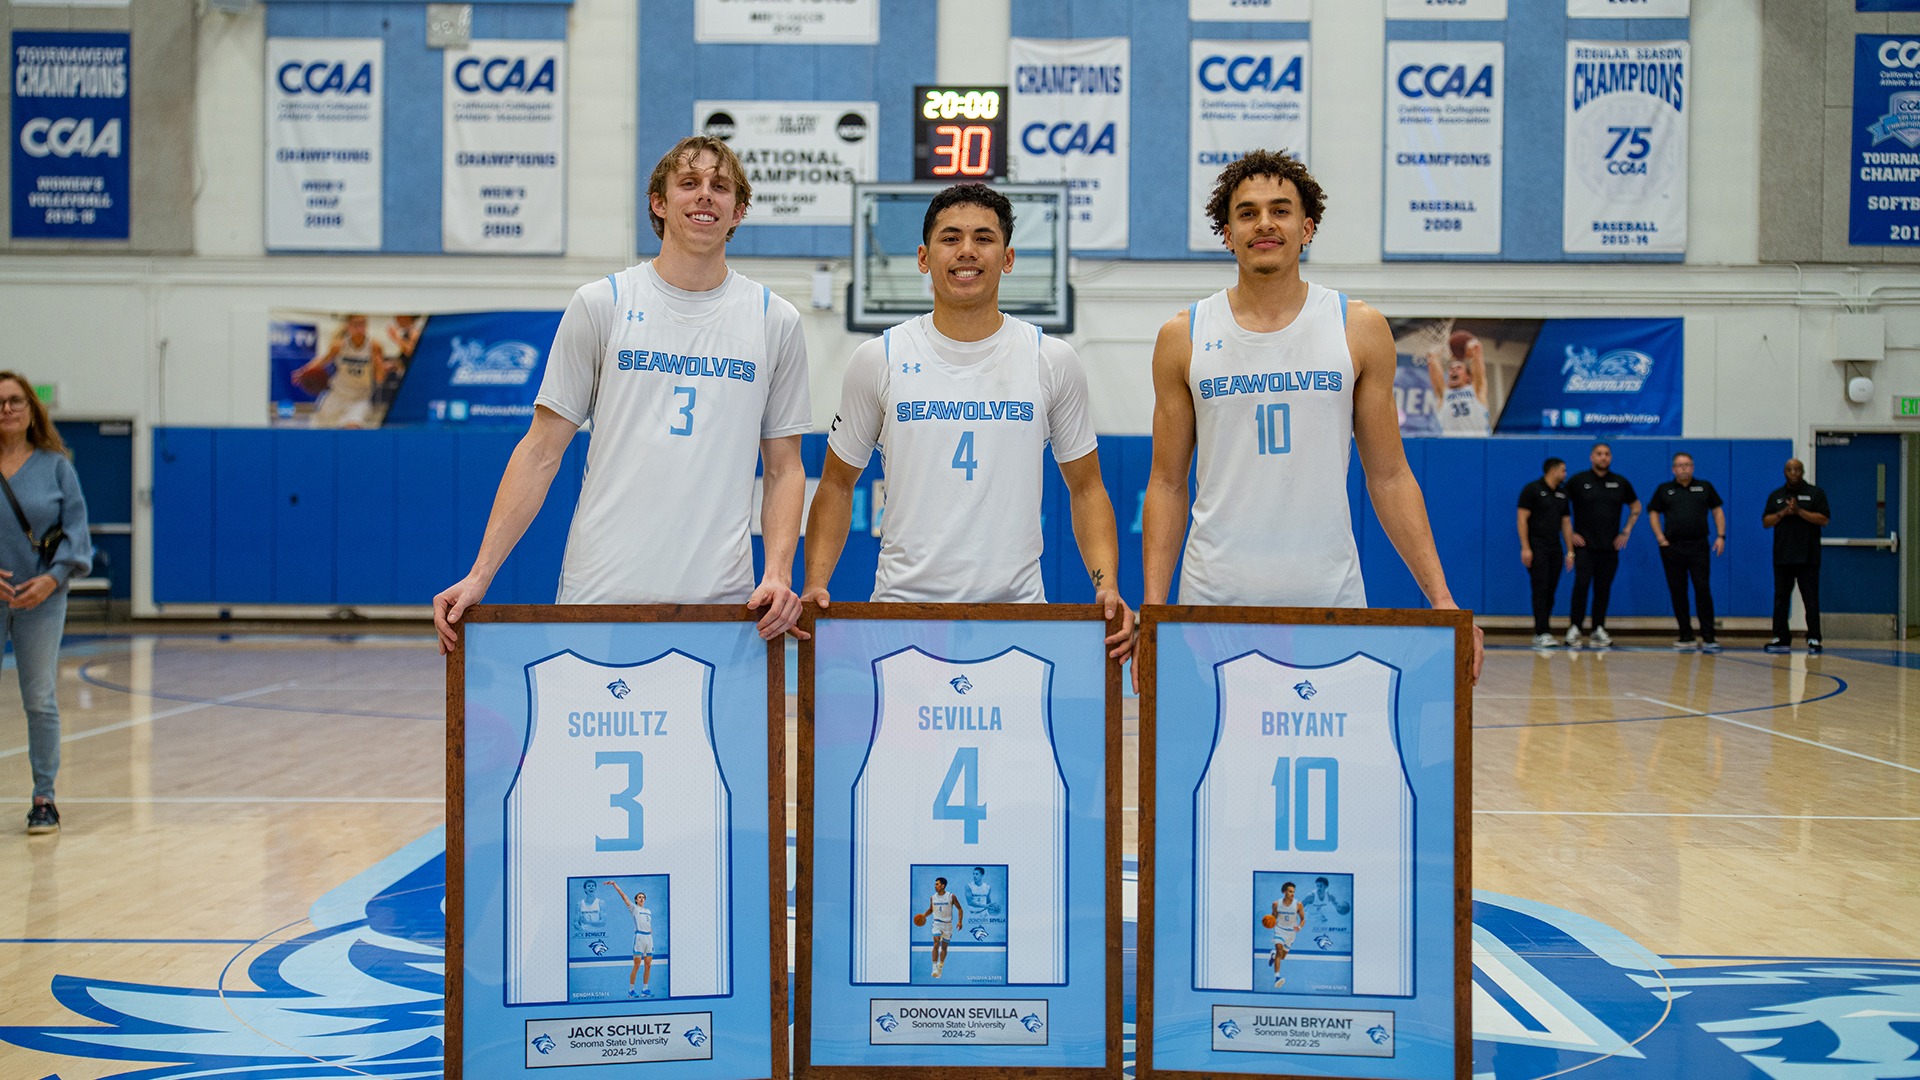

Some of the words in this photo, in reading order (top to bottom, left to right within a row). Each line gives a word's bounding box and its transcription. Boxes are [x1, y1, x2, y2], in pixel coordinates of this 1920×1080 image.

[1575, 47, 1629, 60] REGULAR
[1637, 47, 1683, 60] SEASON
[16, 65, 127, 98] CHAMPIONS
[278, 61, 372, 95] CCAA
[455, 58, 555, 93] CCAA
[1016, 65, 1123, 93] CHAMPIONS
[1198, 56, 1304, 92] CCAA
[1397, 65, 1494, 98] CCAA
[1573, 62, 1684, 113] CHAMPIONS
[923, 90, 1000, 119] 20:00
[20, 117, 121, 158] CCAA
[932, 125, 992, 176] 30
[1022, 122, 1116, 155] CCAA
[1604, 126, 1653, 160] 75
[737, 150, 843, 165] ATIONAL
[1397, 153, 1491, 166] CHAMPIONS
[1607, 160, 1647, 176] CCAA
[37, 176, 104, 192] WOMEN'S
[28, 192, 113, 208] VOLLEYBALL
[1409, 201, 1477, 212] BASEBALL
[1592, 221, 1658, 233] BASEBALL
[618, 350, 756, 383] SEAWOLVES
[1199, 371, 1342, 400] SEAWOLVES
[669, 386, 696, 436] 3
[897, 401, 1034, 422] SEAWOLVES
[1901, 397, 1920, 415] EXI
[1255, 403, 1291, 455] 10
[952, 431, 978, 481] 4
[568, 710, 668, 738] SCHULTZ
[918, 705, 1002, 731] SEVILLA
[1262, 711, 1347, 737] BRYANT
[595, 750, 644, 852] 3
[932, 747, 987, 845] 4
[1271, 757, 1339, 852] 10
[900, 1008, 965, 1019] DONOVAN
[969, 1008, 1018, 1019] SEVILLA
[912, 1021, 944, 1029] Sonoma
[946, 1020, 966, 1029] State
[968, 1021, 1006, 1031] University
[1252, 1015, 1298, 1027] JULIAN
[1301, 1017, 1353, 1029] BRYANT
[568, 1026, 604, 1039] JACK
[607, 1023, 671, 1037] SCHULTZ
[570, 1040, 604, 1049] Sonoma
[606, 1038, 627, 1047] State
[629, 1036, 669, 1047] University
[942, 1030, 976, 1038] 2024-25
[1255, 1028, 1288, 1037] Sonoma
[1290, 1029, 1310, 1038] State
[1312, 1030, 1351, 1041] University
[1285, 1039, 1320, 1048] 2022-25
[602, 1048, 637, 1057] 2024-25
